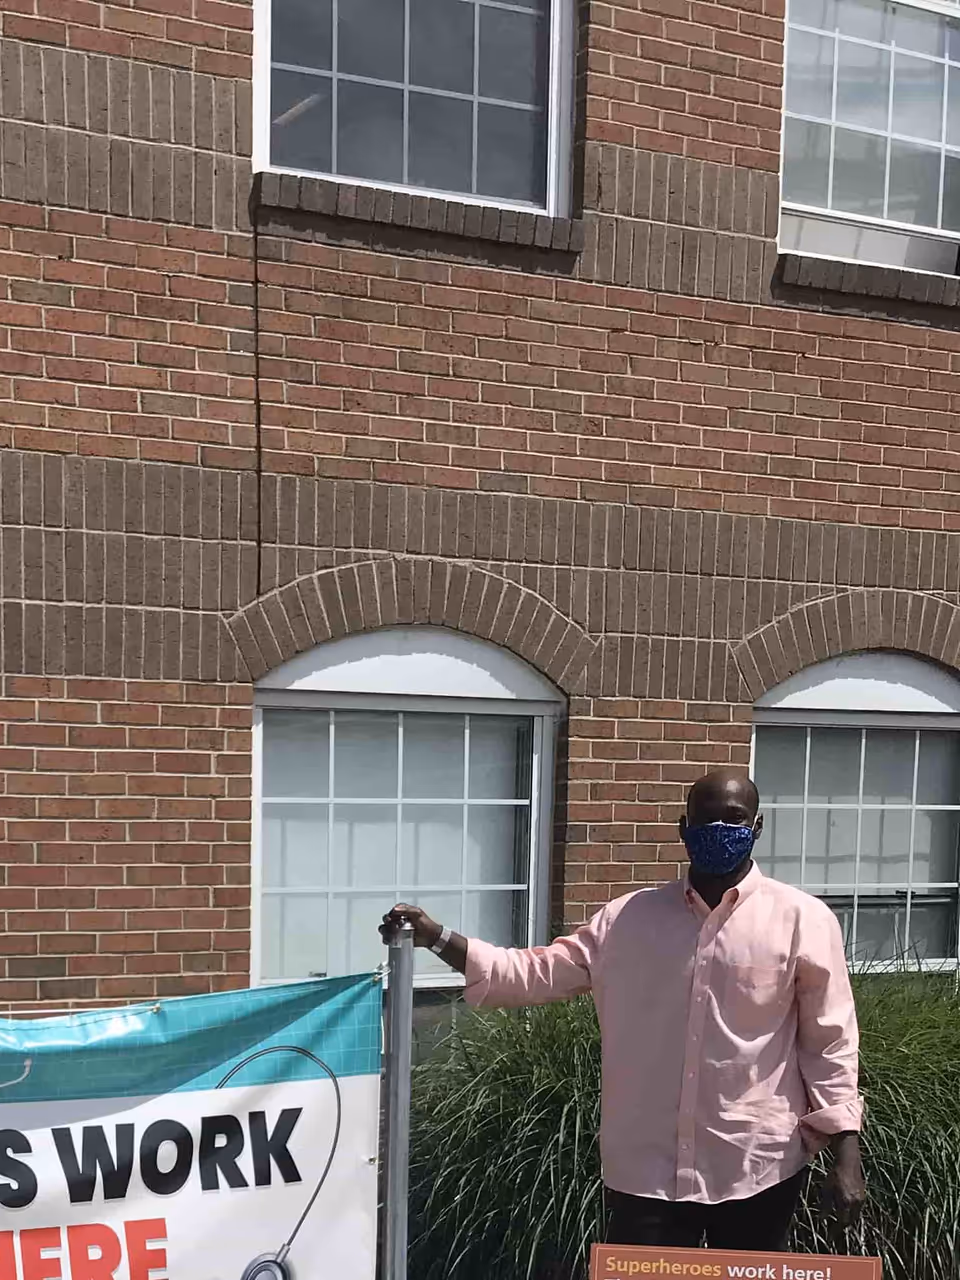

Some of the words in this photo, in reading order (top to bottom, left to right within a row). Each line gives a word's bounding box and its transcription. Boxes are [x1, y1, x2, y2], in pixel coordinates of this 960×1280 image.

[51, 1107, 303, 1204] WORK
[605, 1256, 722, 1276] Superheroes
[727, 1264, 777, 1280] work
